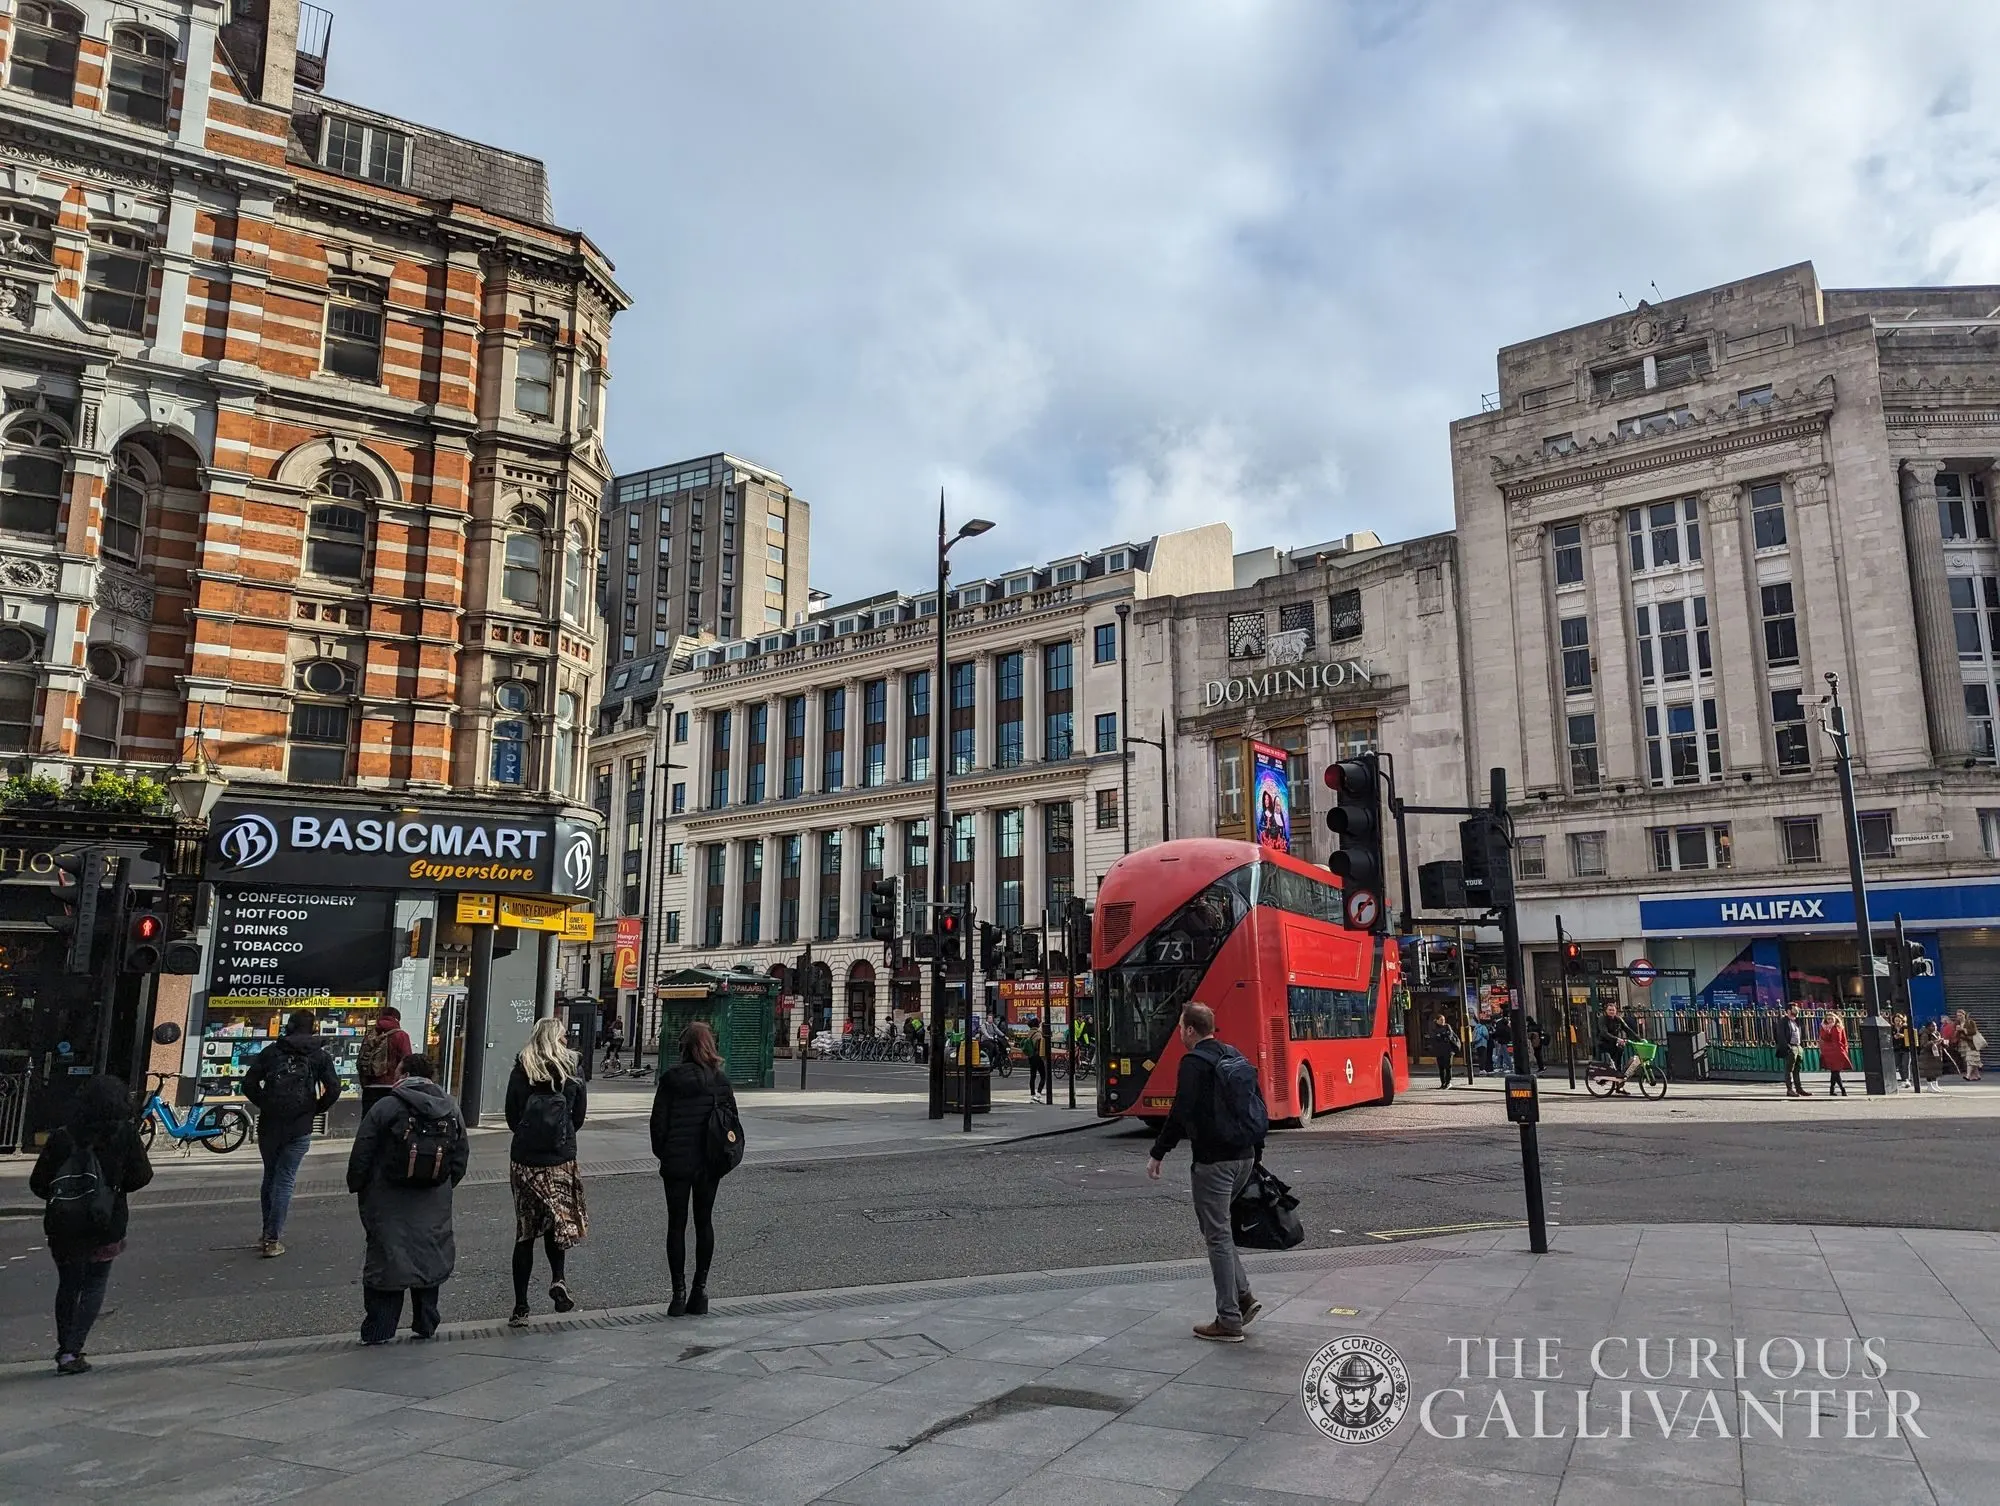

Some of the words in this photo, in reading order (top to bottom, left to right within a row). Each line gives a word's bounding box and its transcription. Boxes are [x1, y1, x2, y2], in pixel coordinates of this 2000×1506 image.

[1204, 659, 1374, 708] DOMINION
[291, 815, 547, 860] BASICMART
[409, 859, 536, 882] Superstore
[238, 892, 357, 906] CONFECTIONERY
[235, 908, 266, 919] HOT
[268, 909, 308, 920] FOOD
[512, 902, 534, 917] MONEY
[534, 904, 563, 921] EXCHANGE
[1721, 899, 1825, 921] HALIFAX
[234, 924, 289, 936] DRINKS
[617, 933, 639, 941] Hungry?
[233, 940, 304, 953] TOBACCO
[1158, 941, 1184, 961] 73
[231, 957, 279, 968] VAPES
[229, 974, 285, 985] MOBILE
[227, 987, 330, 998] ACCESSORIES
[268, 997, 294, 1006] MONEY
[294, 997, 332, 1006] EXCHANGE
[1013, 998, 1026, 1007] BUY
[1052, 997, 1069, 1006] HERE
[1511, 1090, 1532, 1098] WAIT
